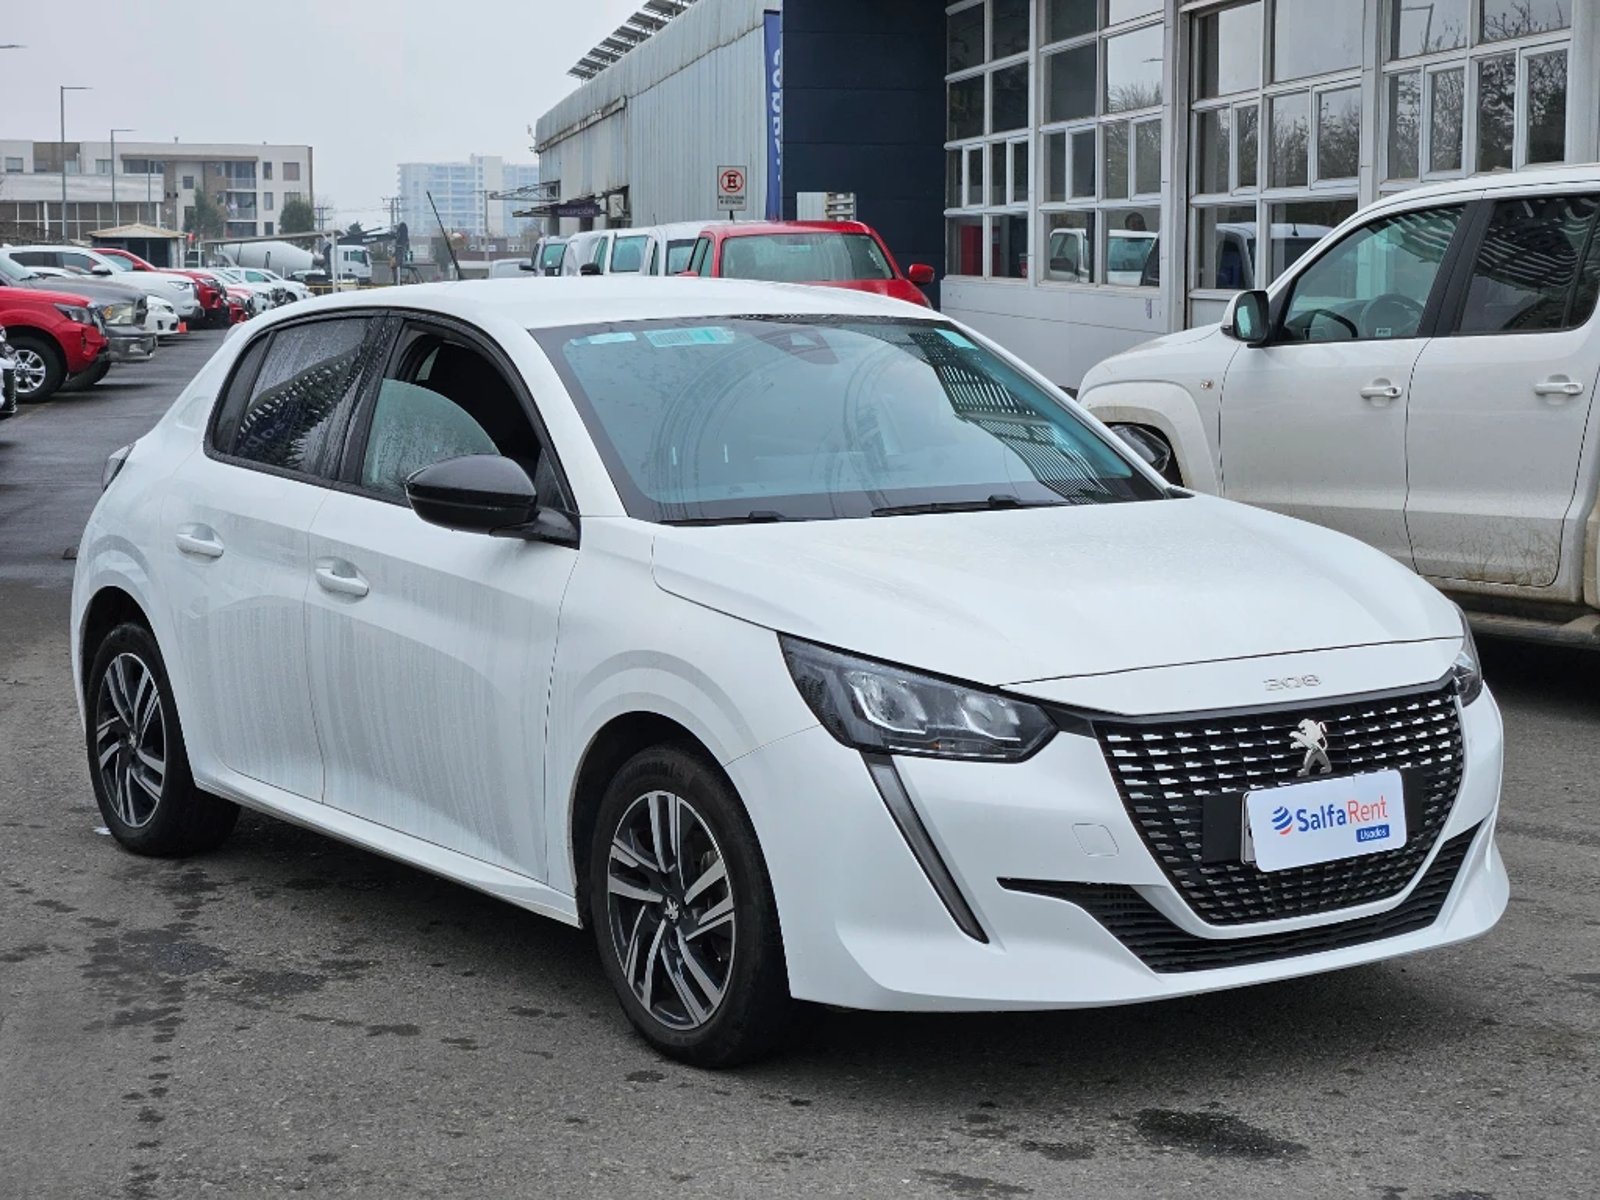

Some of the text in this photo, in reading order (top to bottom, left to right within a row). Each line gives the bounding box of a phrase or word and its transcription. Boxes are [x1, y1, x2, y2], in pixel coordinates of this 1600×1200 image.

[1263, 674, 1322, 692] 208
[1296, 795, 1388, 832] SalfaRent
[1360, 827, 1387, 840] Usados
